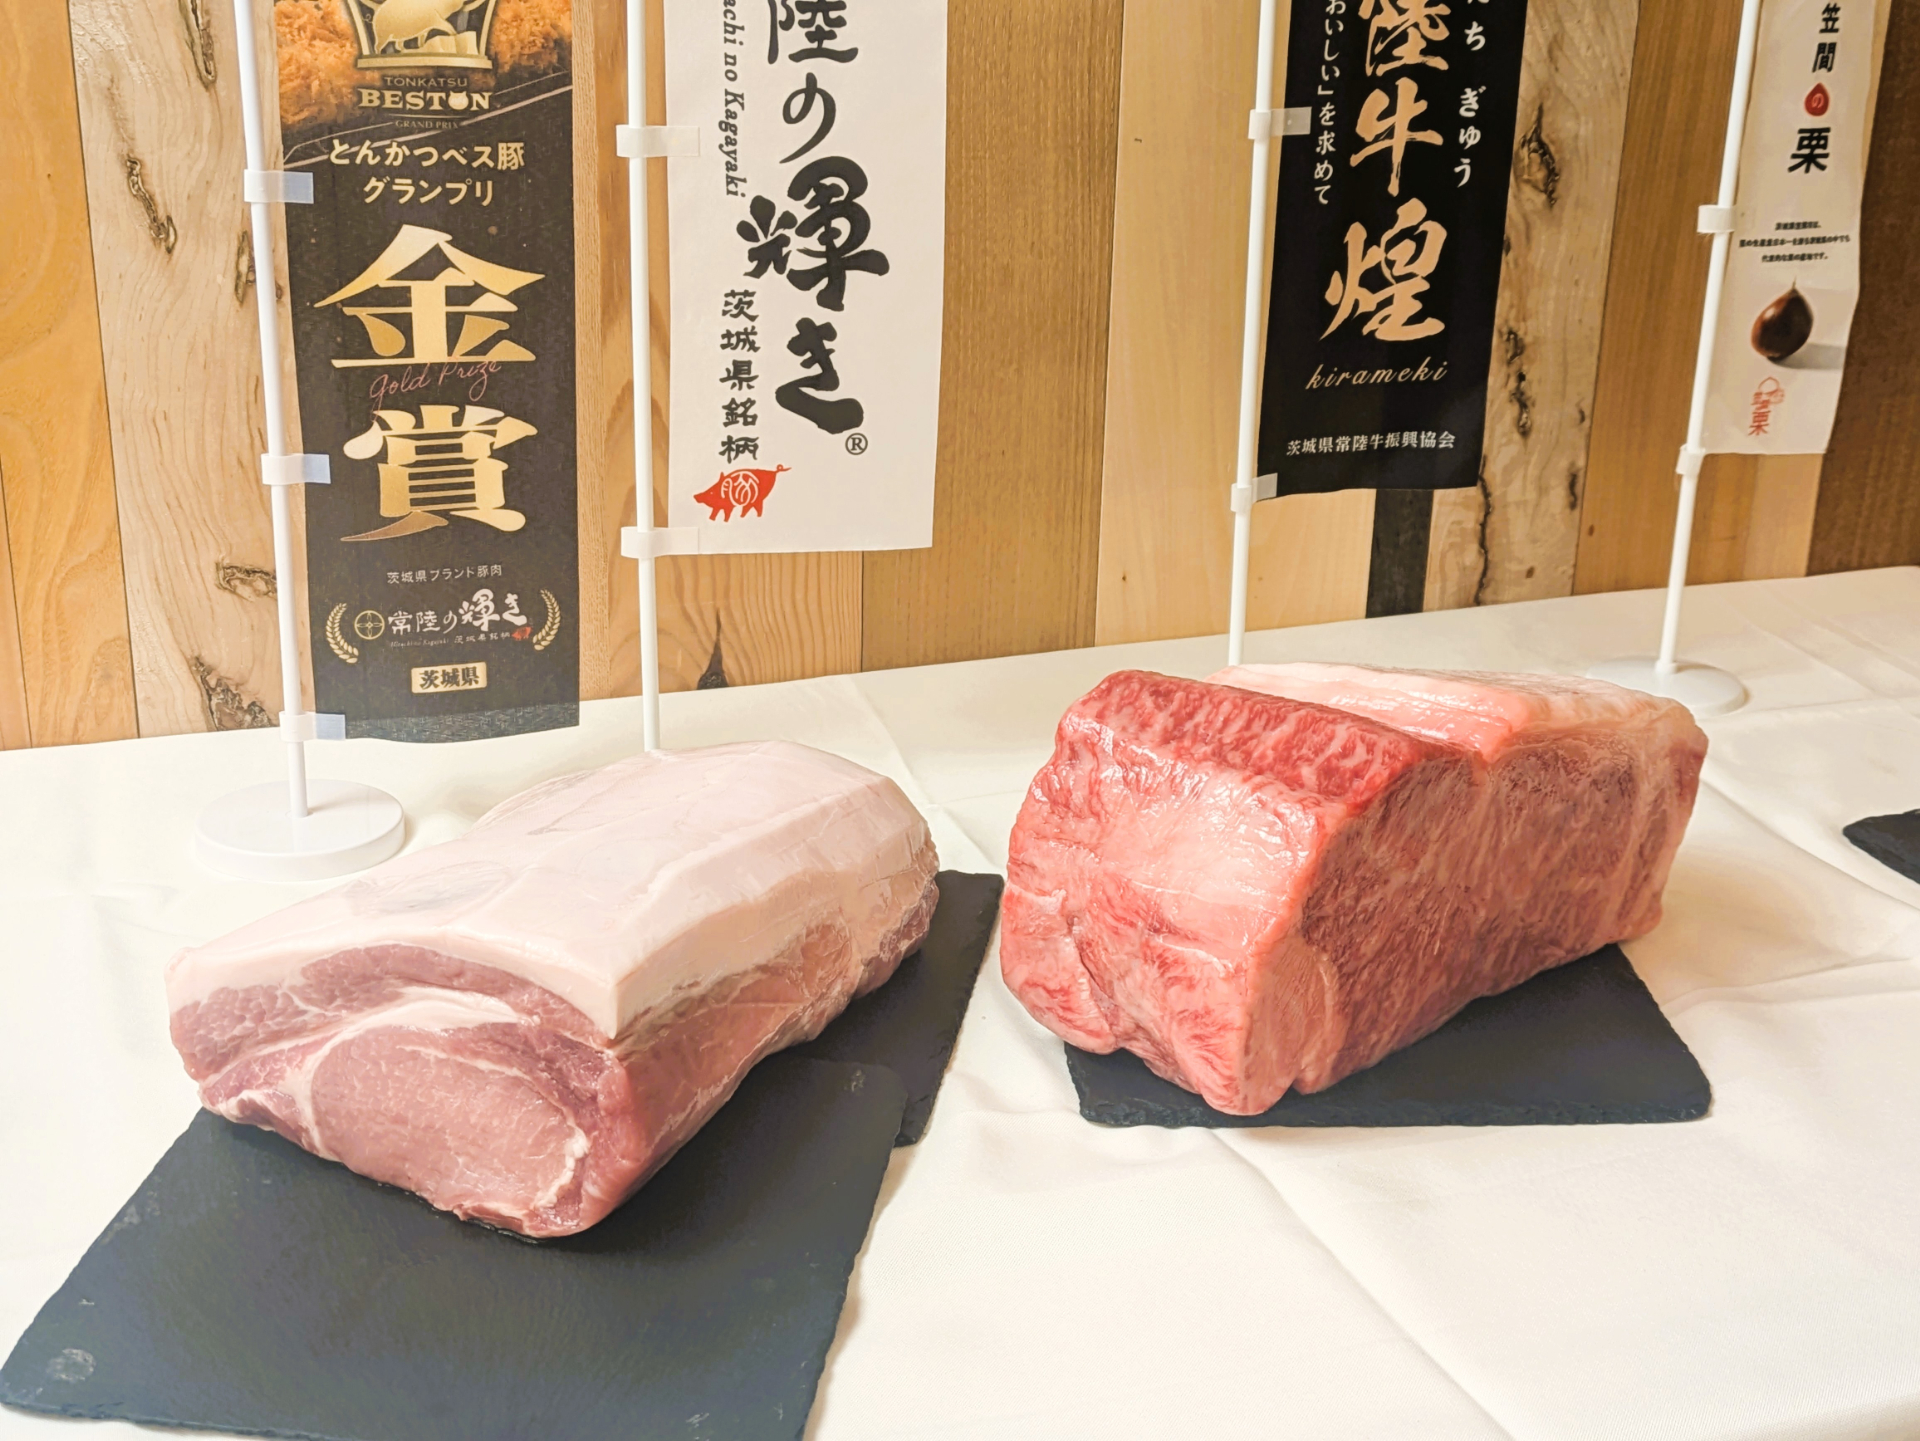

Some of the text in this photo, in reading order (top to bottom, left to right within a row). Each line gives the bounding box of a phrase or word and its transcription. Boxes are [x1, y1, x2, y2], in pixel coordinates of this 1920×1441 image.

[384, 76, 468, 87] TONKATSU
[723, 52, 739, 82] no
[1453, 0, 1489, 188] ちぎゅう
[395, 119, 460, 130] GRAND PRIX
[328, 139, 525, 171] とんかつベス豚
[718, 88, 748, 198] Kagayaki
[363, 175, 494, 207] グランプリ
[718, 289, 761, 464] 茨城県銘柄
[1304, 356, 1449, 390] kirameki
[1286, 431, 1456, 456] 茨城県常陸牛振興協会
[386, 564, 503, 585] 茨城県ブランド豚肉
[387, 588, 528, 635] 常陸の輝き
[418, 666, 480, 690] 茨城県
